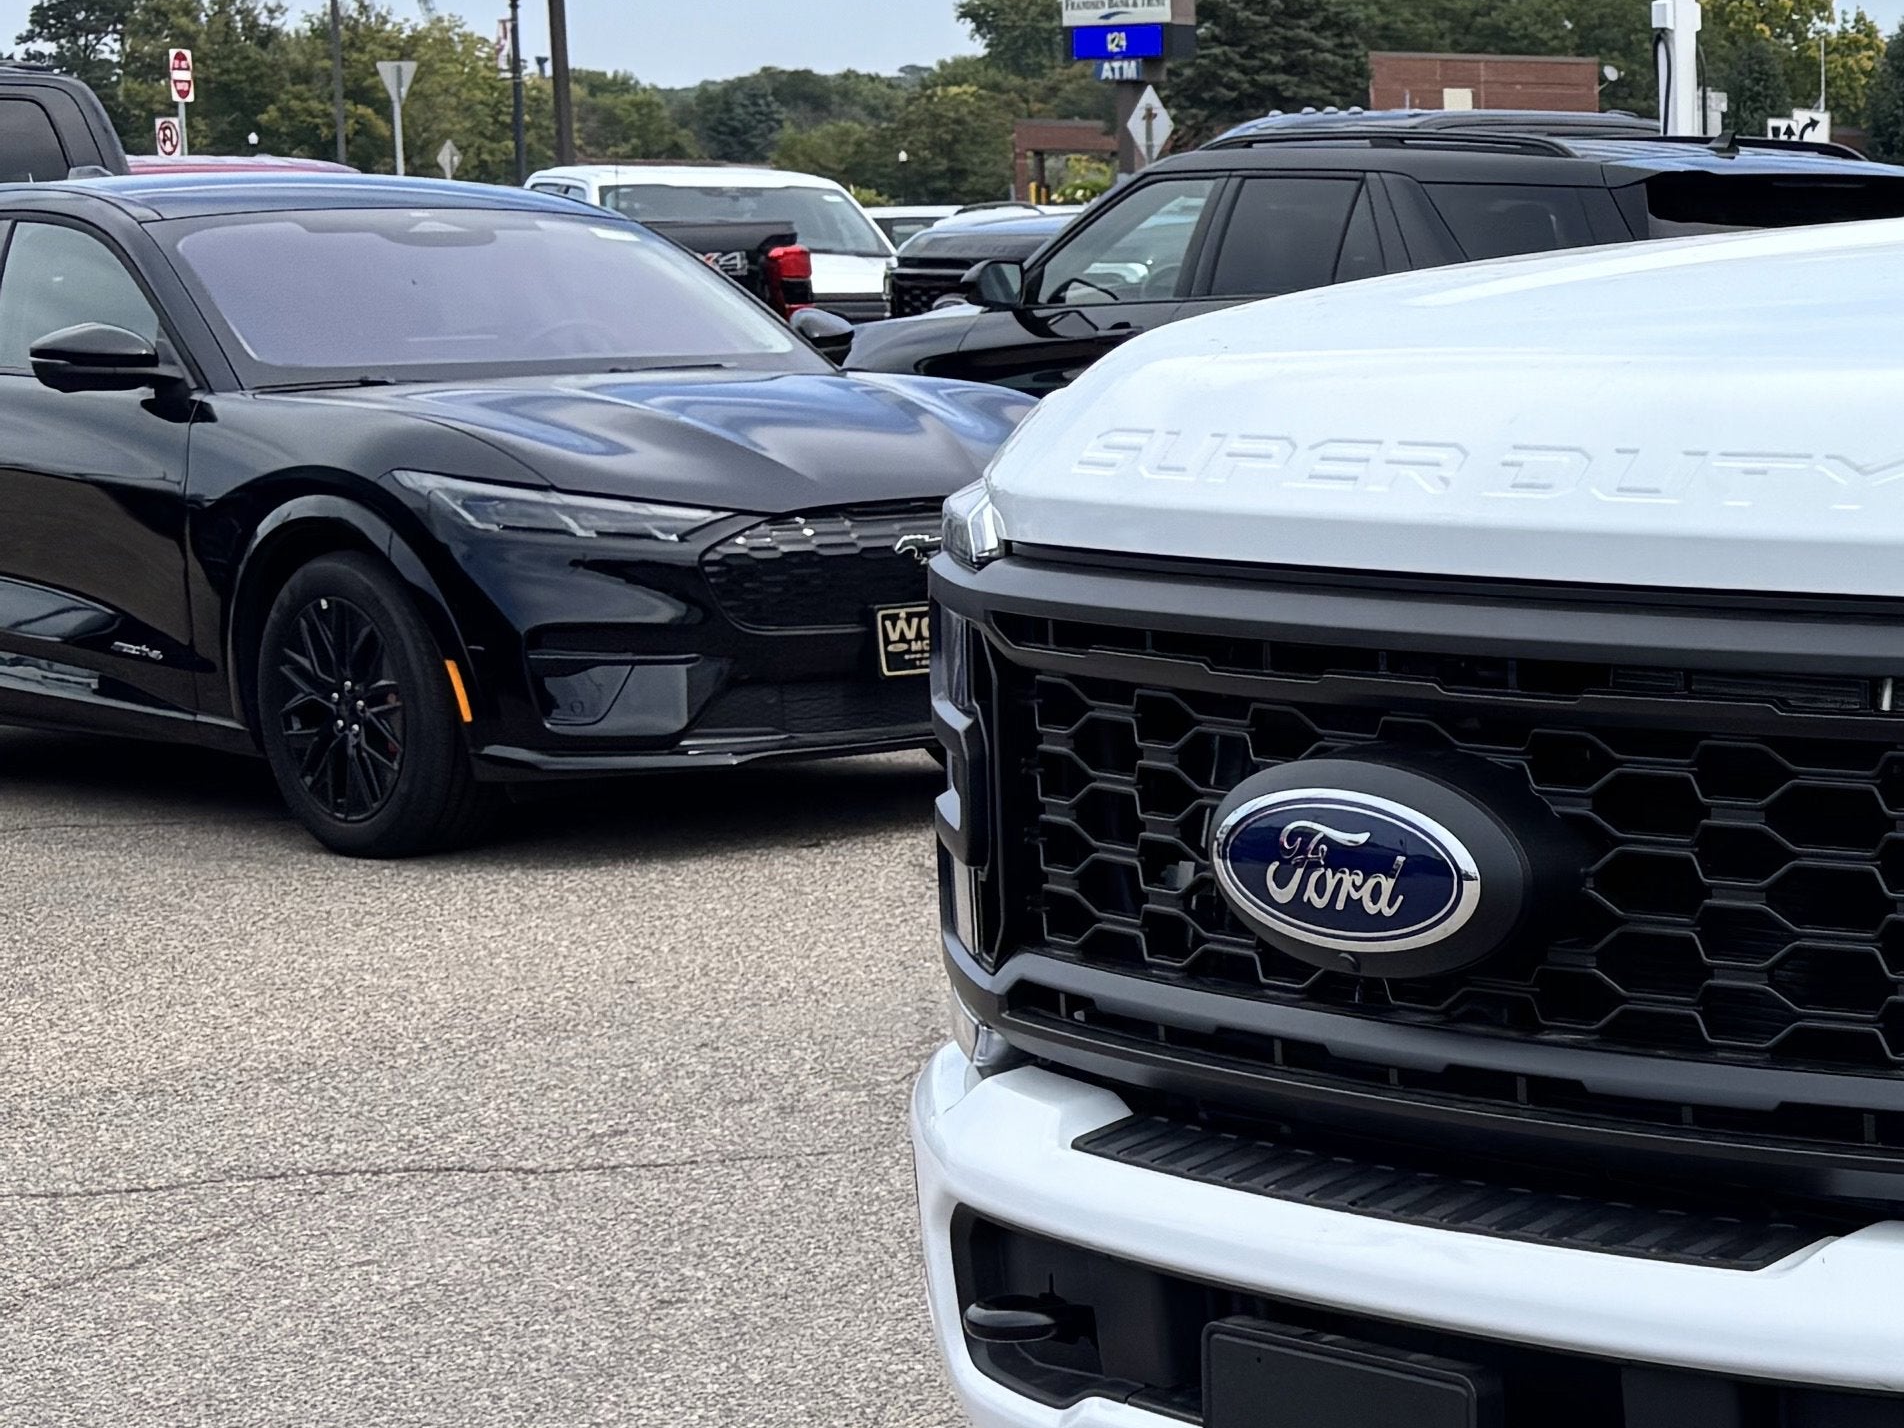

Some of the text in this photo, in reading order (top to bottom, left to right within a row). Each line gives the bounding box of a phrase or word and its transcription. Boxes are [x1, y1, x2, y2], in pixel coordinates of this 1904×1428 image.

[1101, 60, 1138, 80] ATM
[1070, 427, 1470, 495] SUPER
[1266, 820, 1406, 917] Ford
